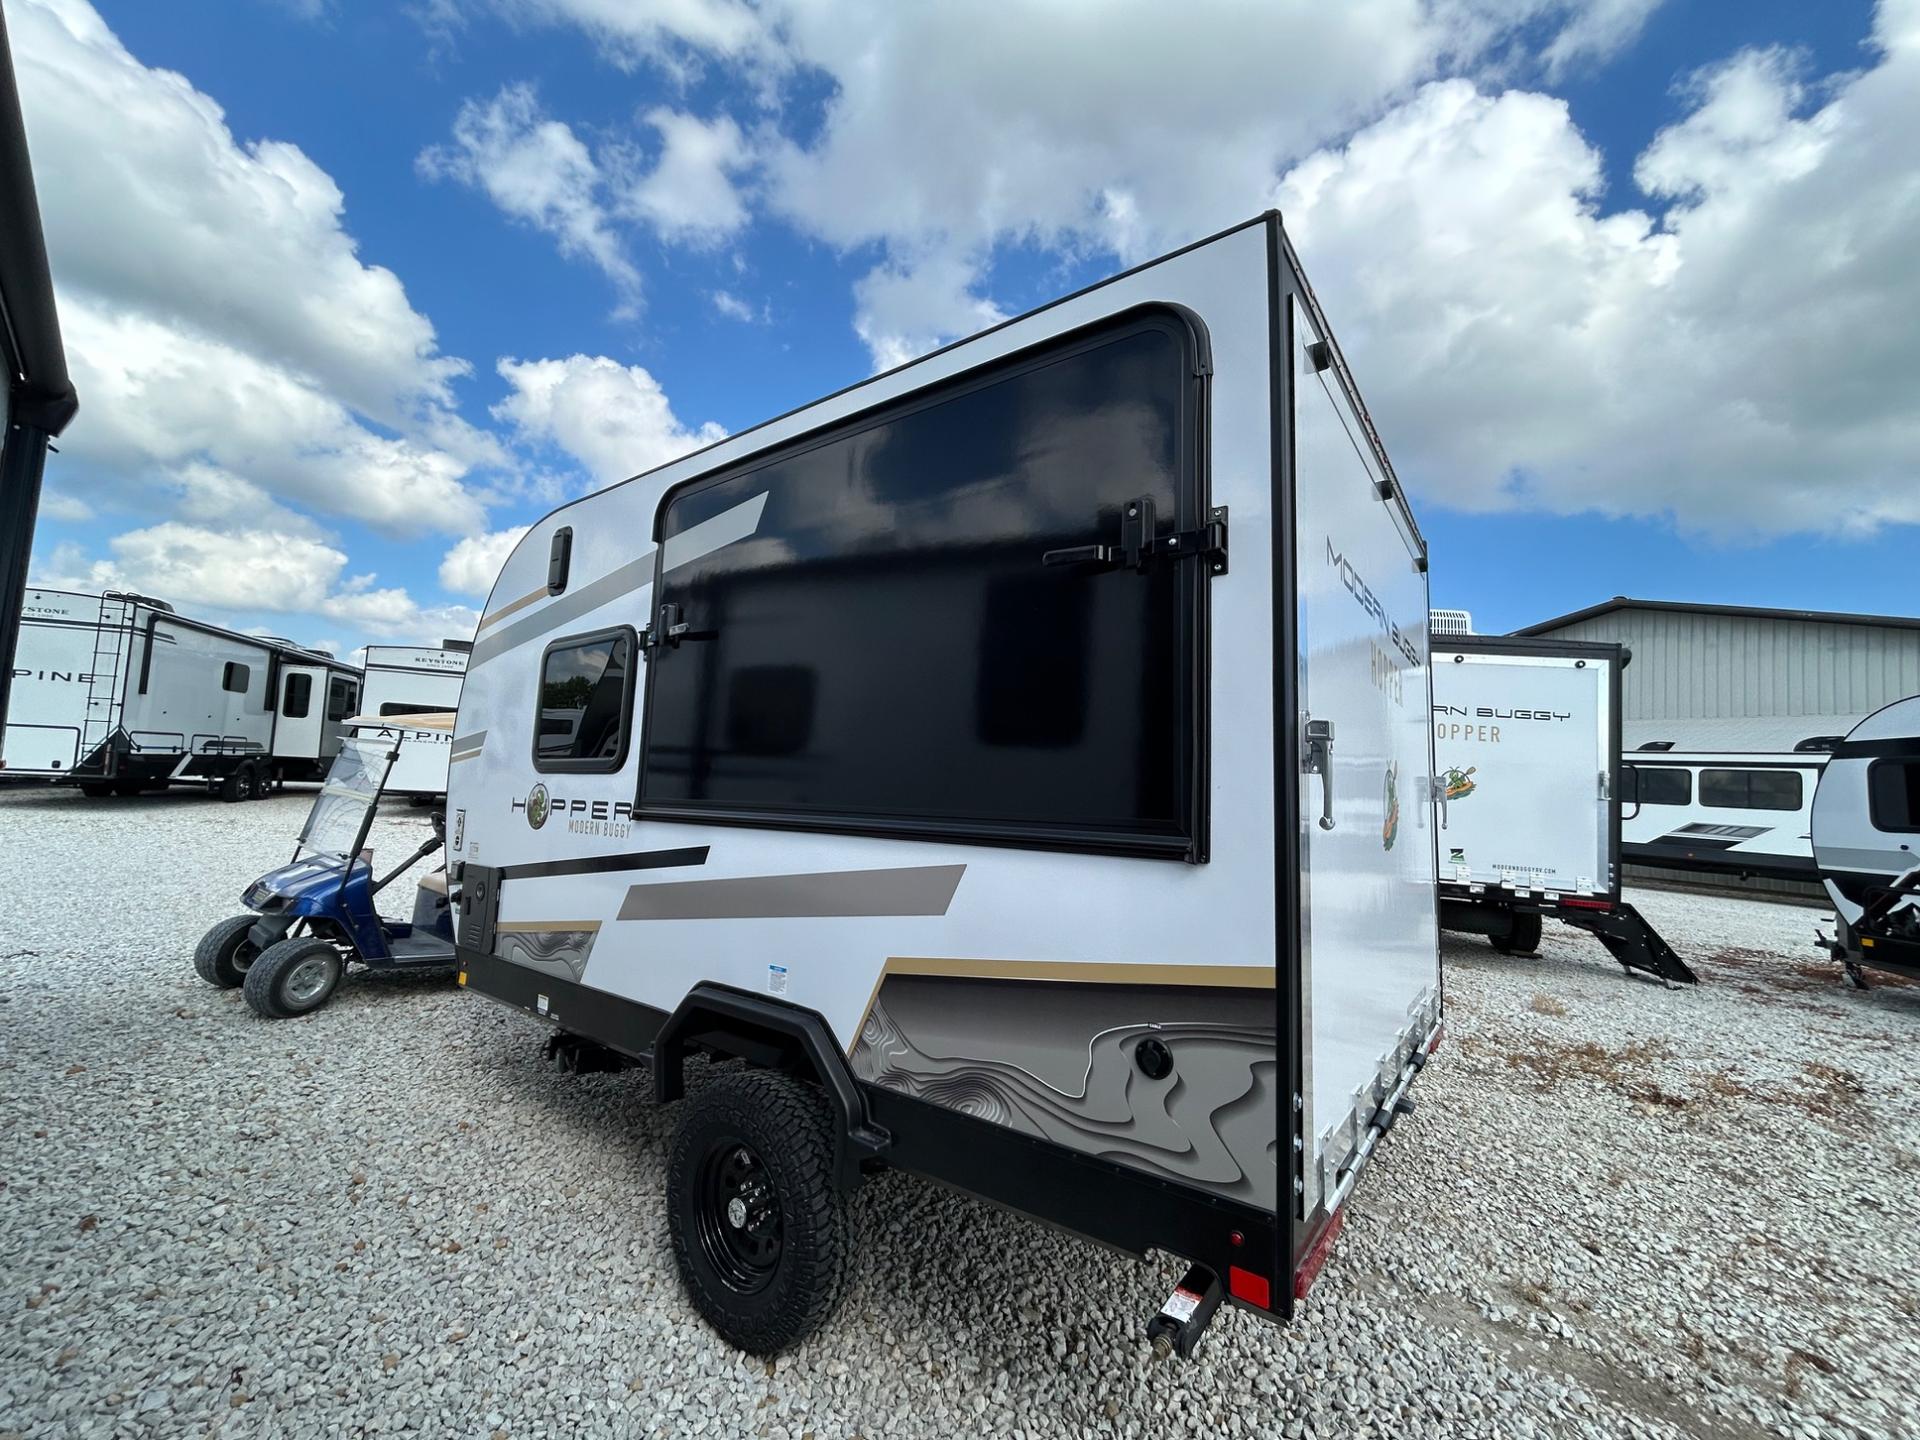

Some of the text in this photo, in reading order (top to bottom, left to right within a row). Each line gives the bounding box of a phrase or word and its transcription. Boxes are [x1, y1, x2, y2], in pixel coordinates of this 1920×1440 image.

[415, 657, 464, 666] KEYSTONE
[12, 669, 96, 683] PINE
[1476, 707, 1571, 722] BUGGY
[1437, 723, 1501, 743] OPPER
[568, 820, 632, 838] MODERN BUGGY
